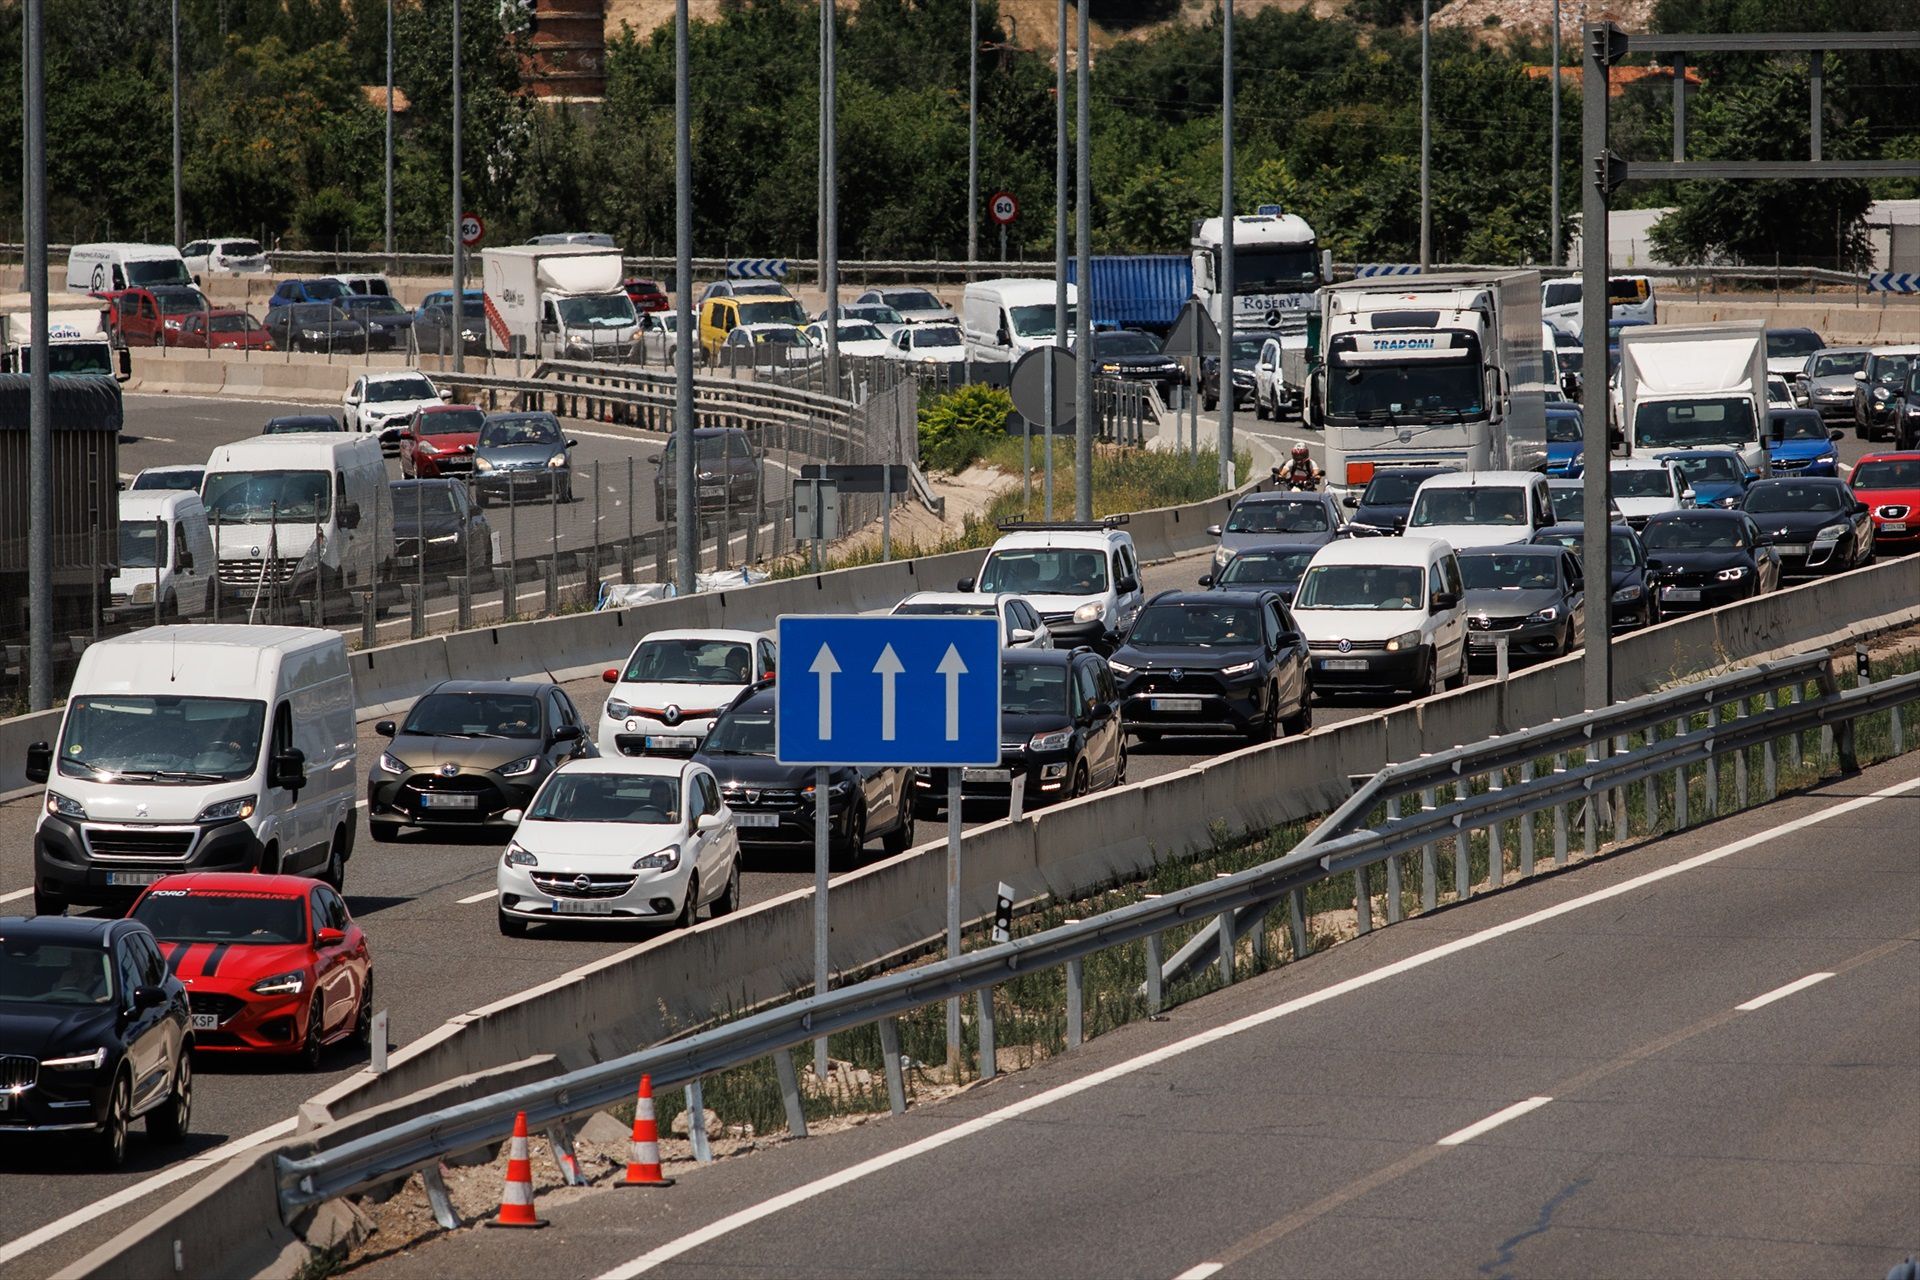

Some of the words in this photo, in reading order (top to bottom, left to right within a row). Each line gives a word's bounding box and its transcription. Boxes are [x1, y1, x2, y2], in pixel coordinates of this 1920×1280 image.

[997, 202, 1012, 213] 60
[1243, 297, 1301, 310] ROSERVE
[1373, 338, 1435, 350] TRADOMI
[187, 890, 300, 901] PERFORMANCE
[192, 1015, 215, 1028] KSP
